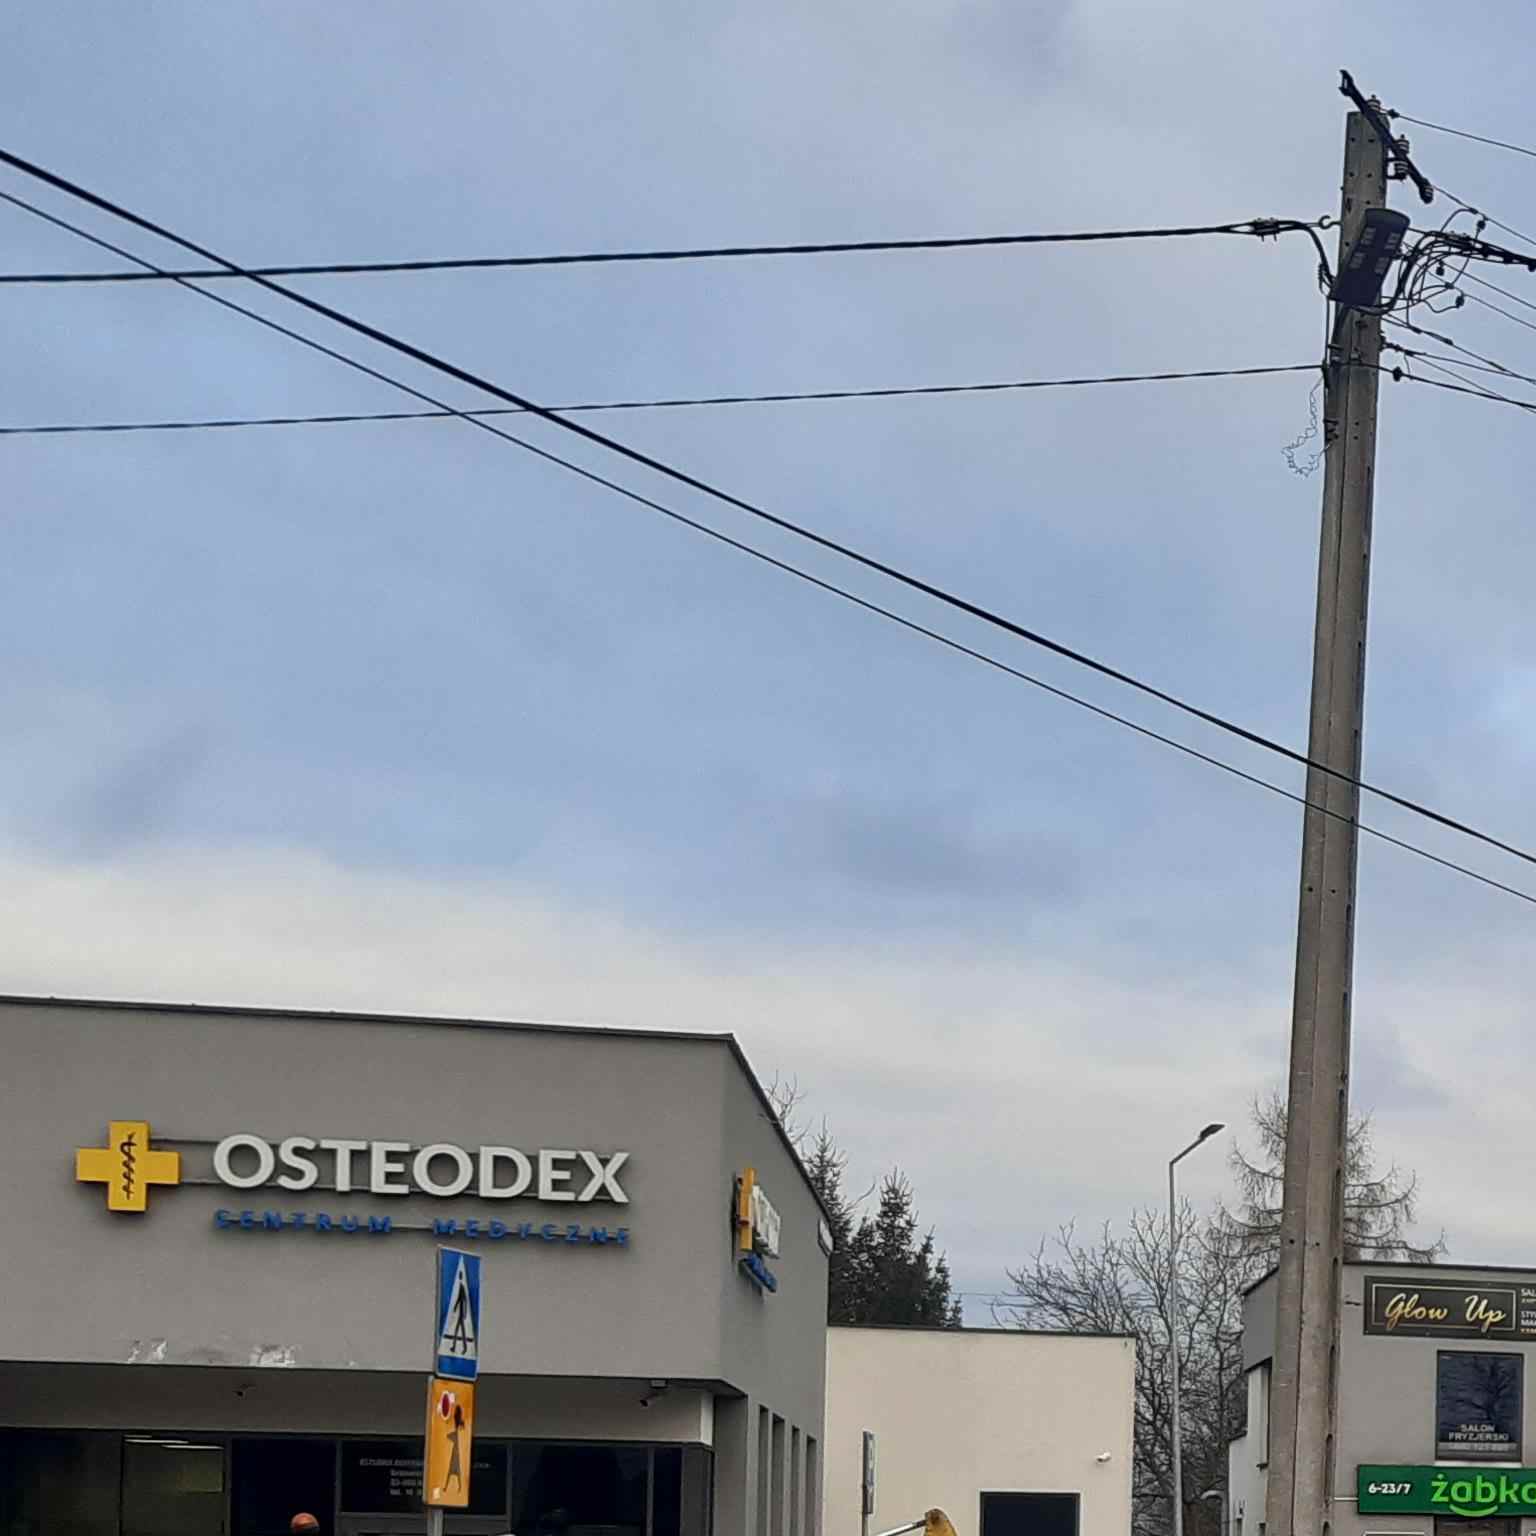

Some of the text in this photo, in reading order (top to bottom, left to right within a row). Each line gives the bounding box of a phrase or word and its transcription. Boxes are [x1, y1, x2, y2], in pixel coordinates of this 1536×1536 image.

[213, 1134, 630, 1203] OSTEODEX
[214, 1209, 630, 1246] CENTRUM MEDYCZNE
[1384, 1293, 1506, 1332] Glow Up
[1460, 1424, 1495, 1432] SALON
[1368, 1483, 1411, 1494] 6-23/7
